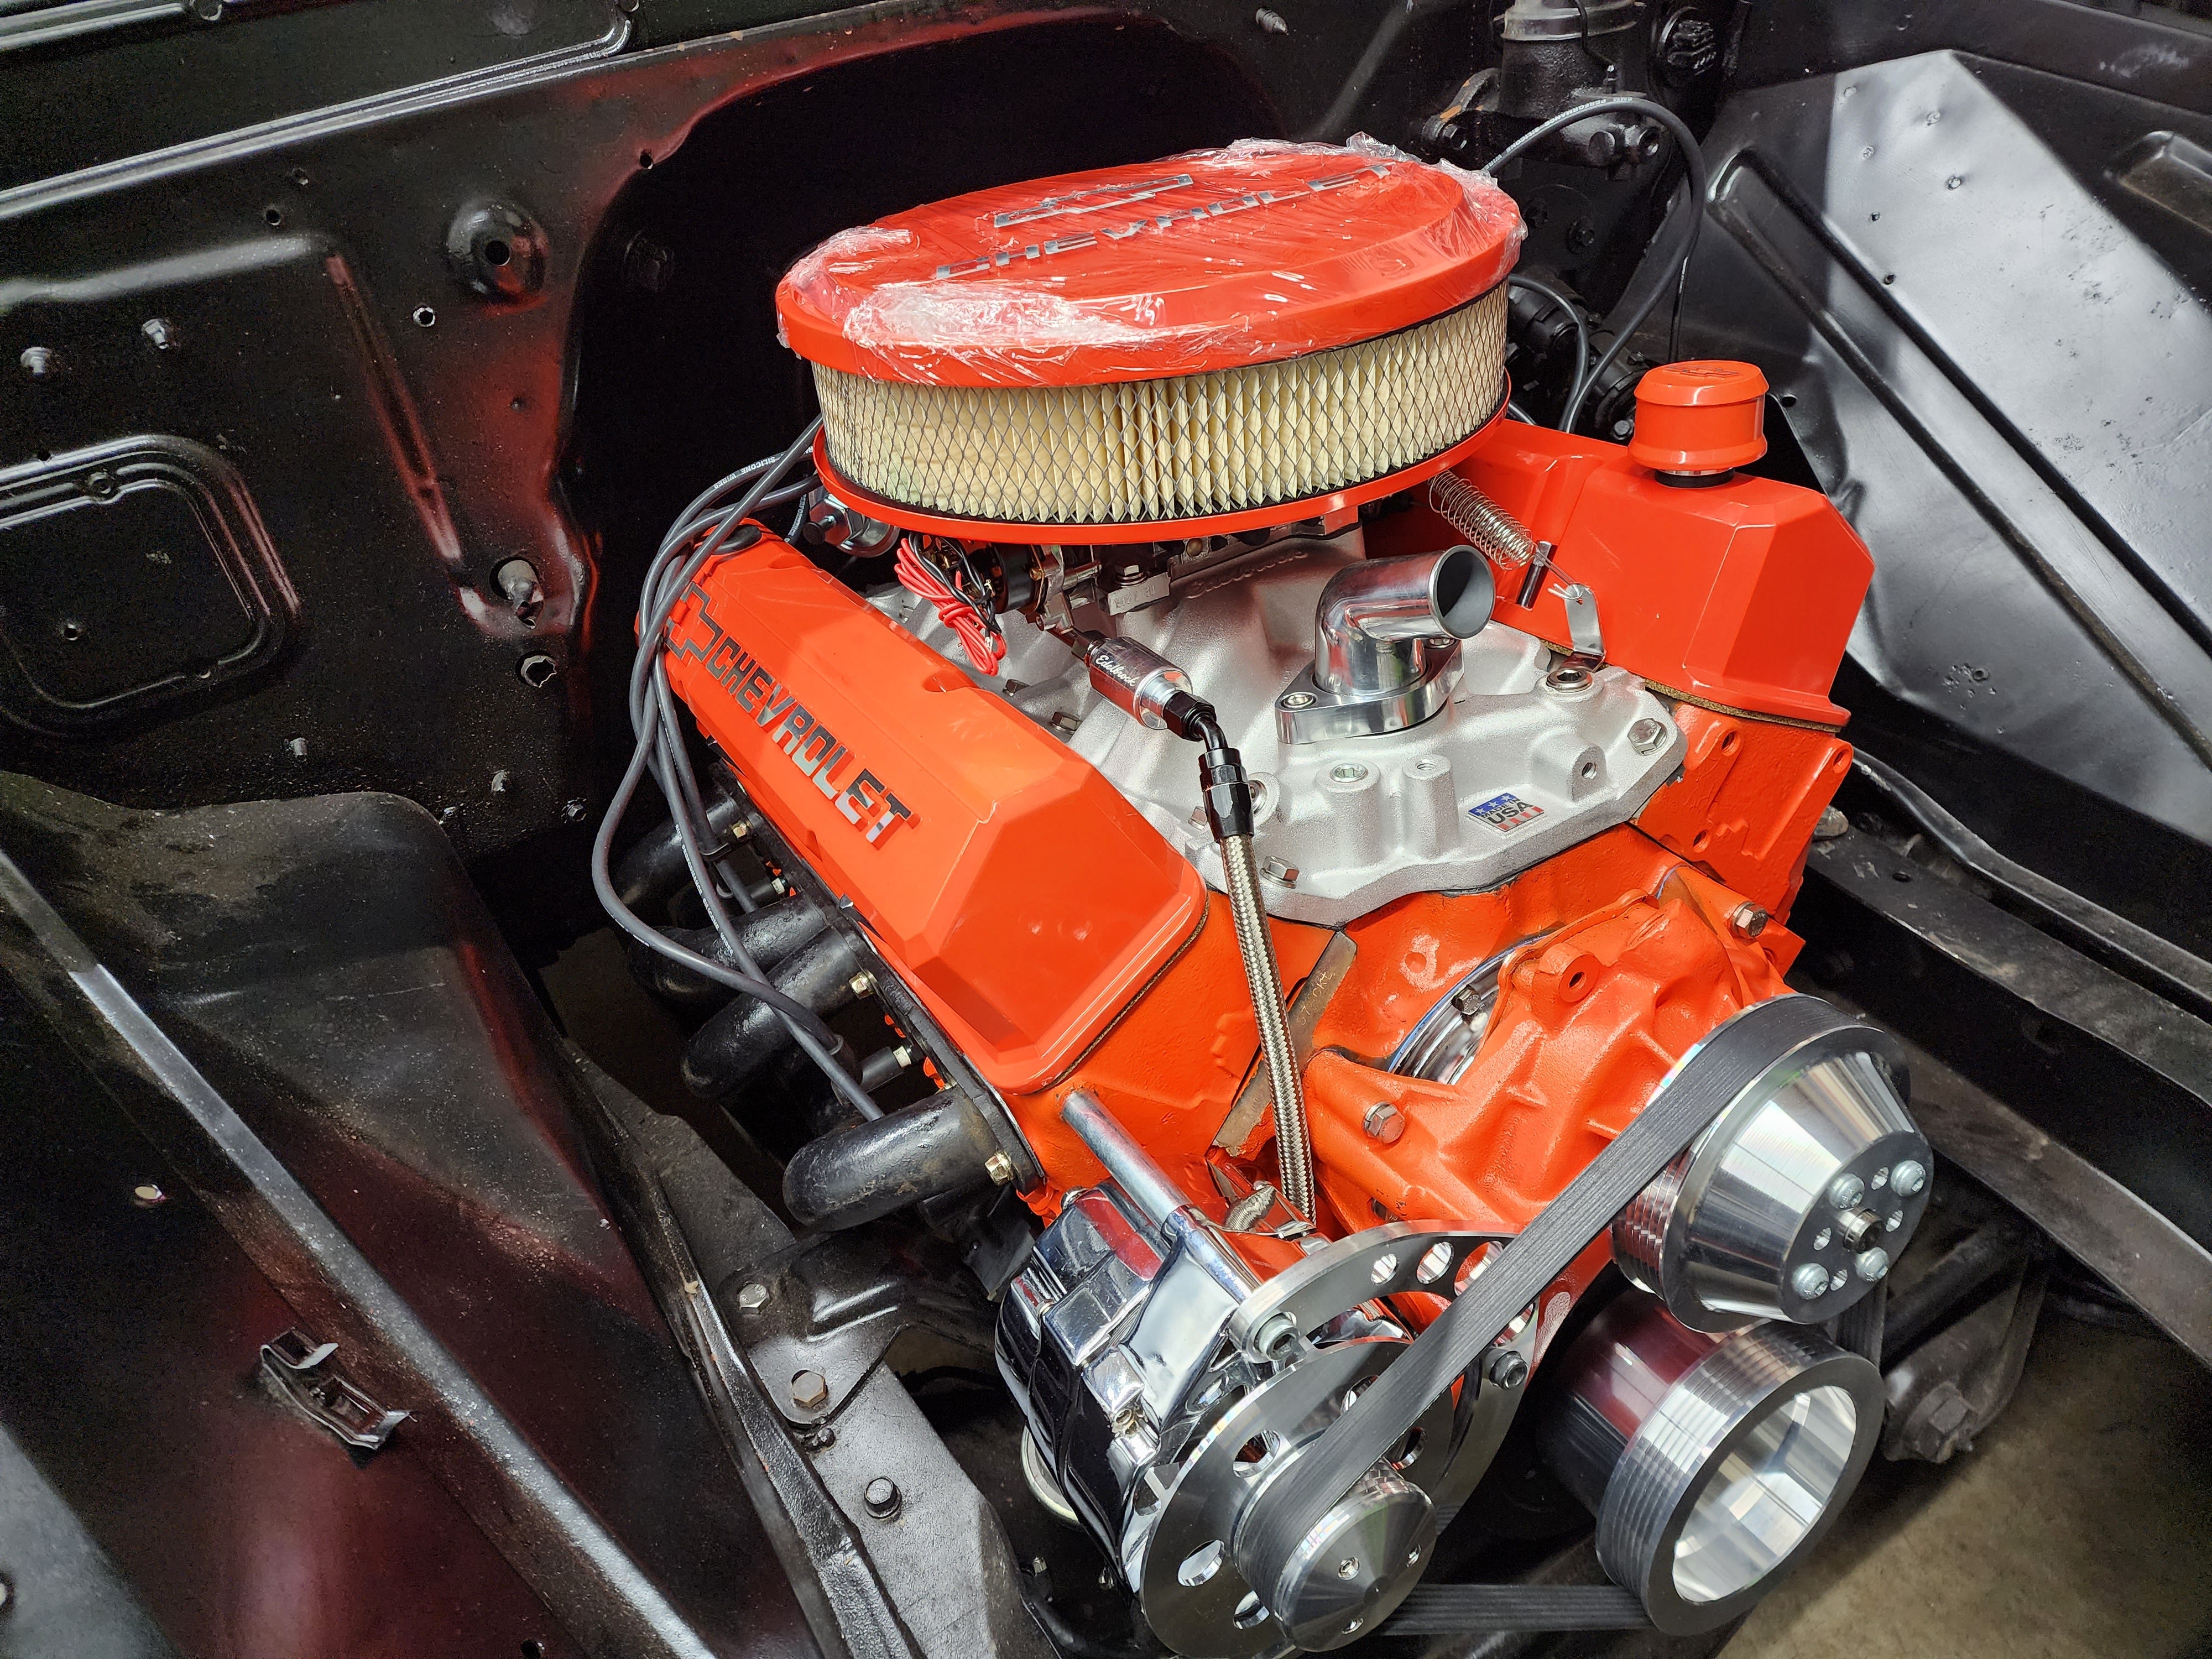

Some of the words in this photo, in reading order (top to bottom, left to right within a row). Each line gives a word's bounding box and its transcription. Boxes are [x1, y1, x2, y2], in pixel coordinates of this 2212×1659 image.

[1545, 98, 1606, 127] PERFORMANCE
[1505, 126, 1541, 154] SILICONE
[936, 161, 1396, 279] CHEVROLET
[740, 456, 776, 474] SILICONE
[713, 473, 737, 489] WIRES
[1095, 655, 1140, 687] Edelbrock
[706, 635, 912, 844] CHEVROLET
[1481, 804, 1509, 818] MADE
[1486, 801, 1535, 824] USA
